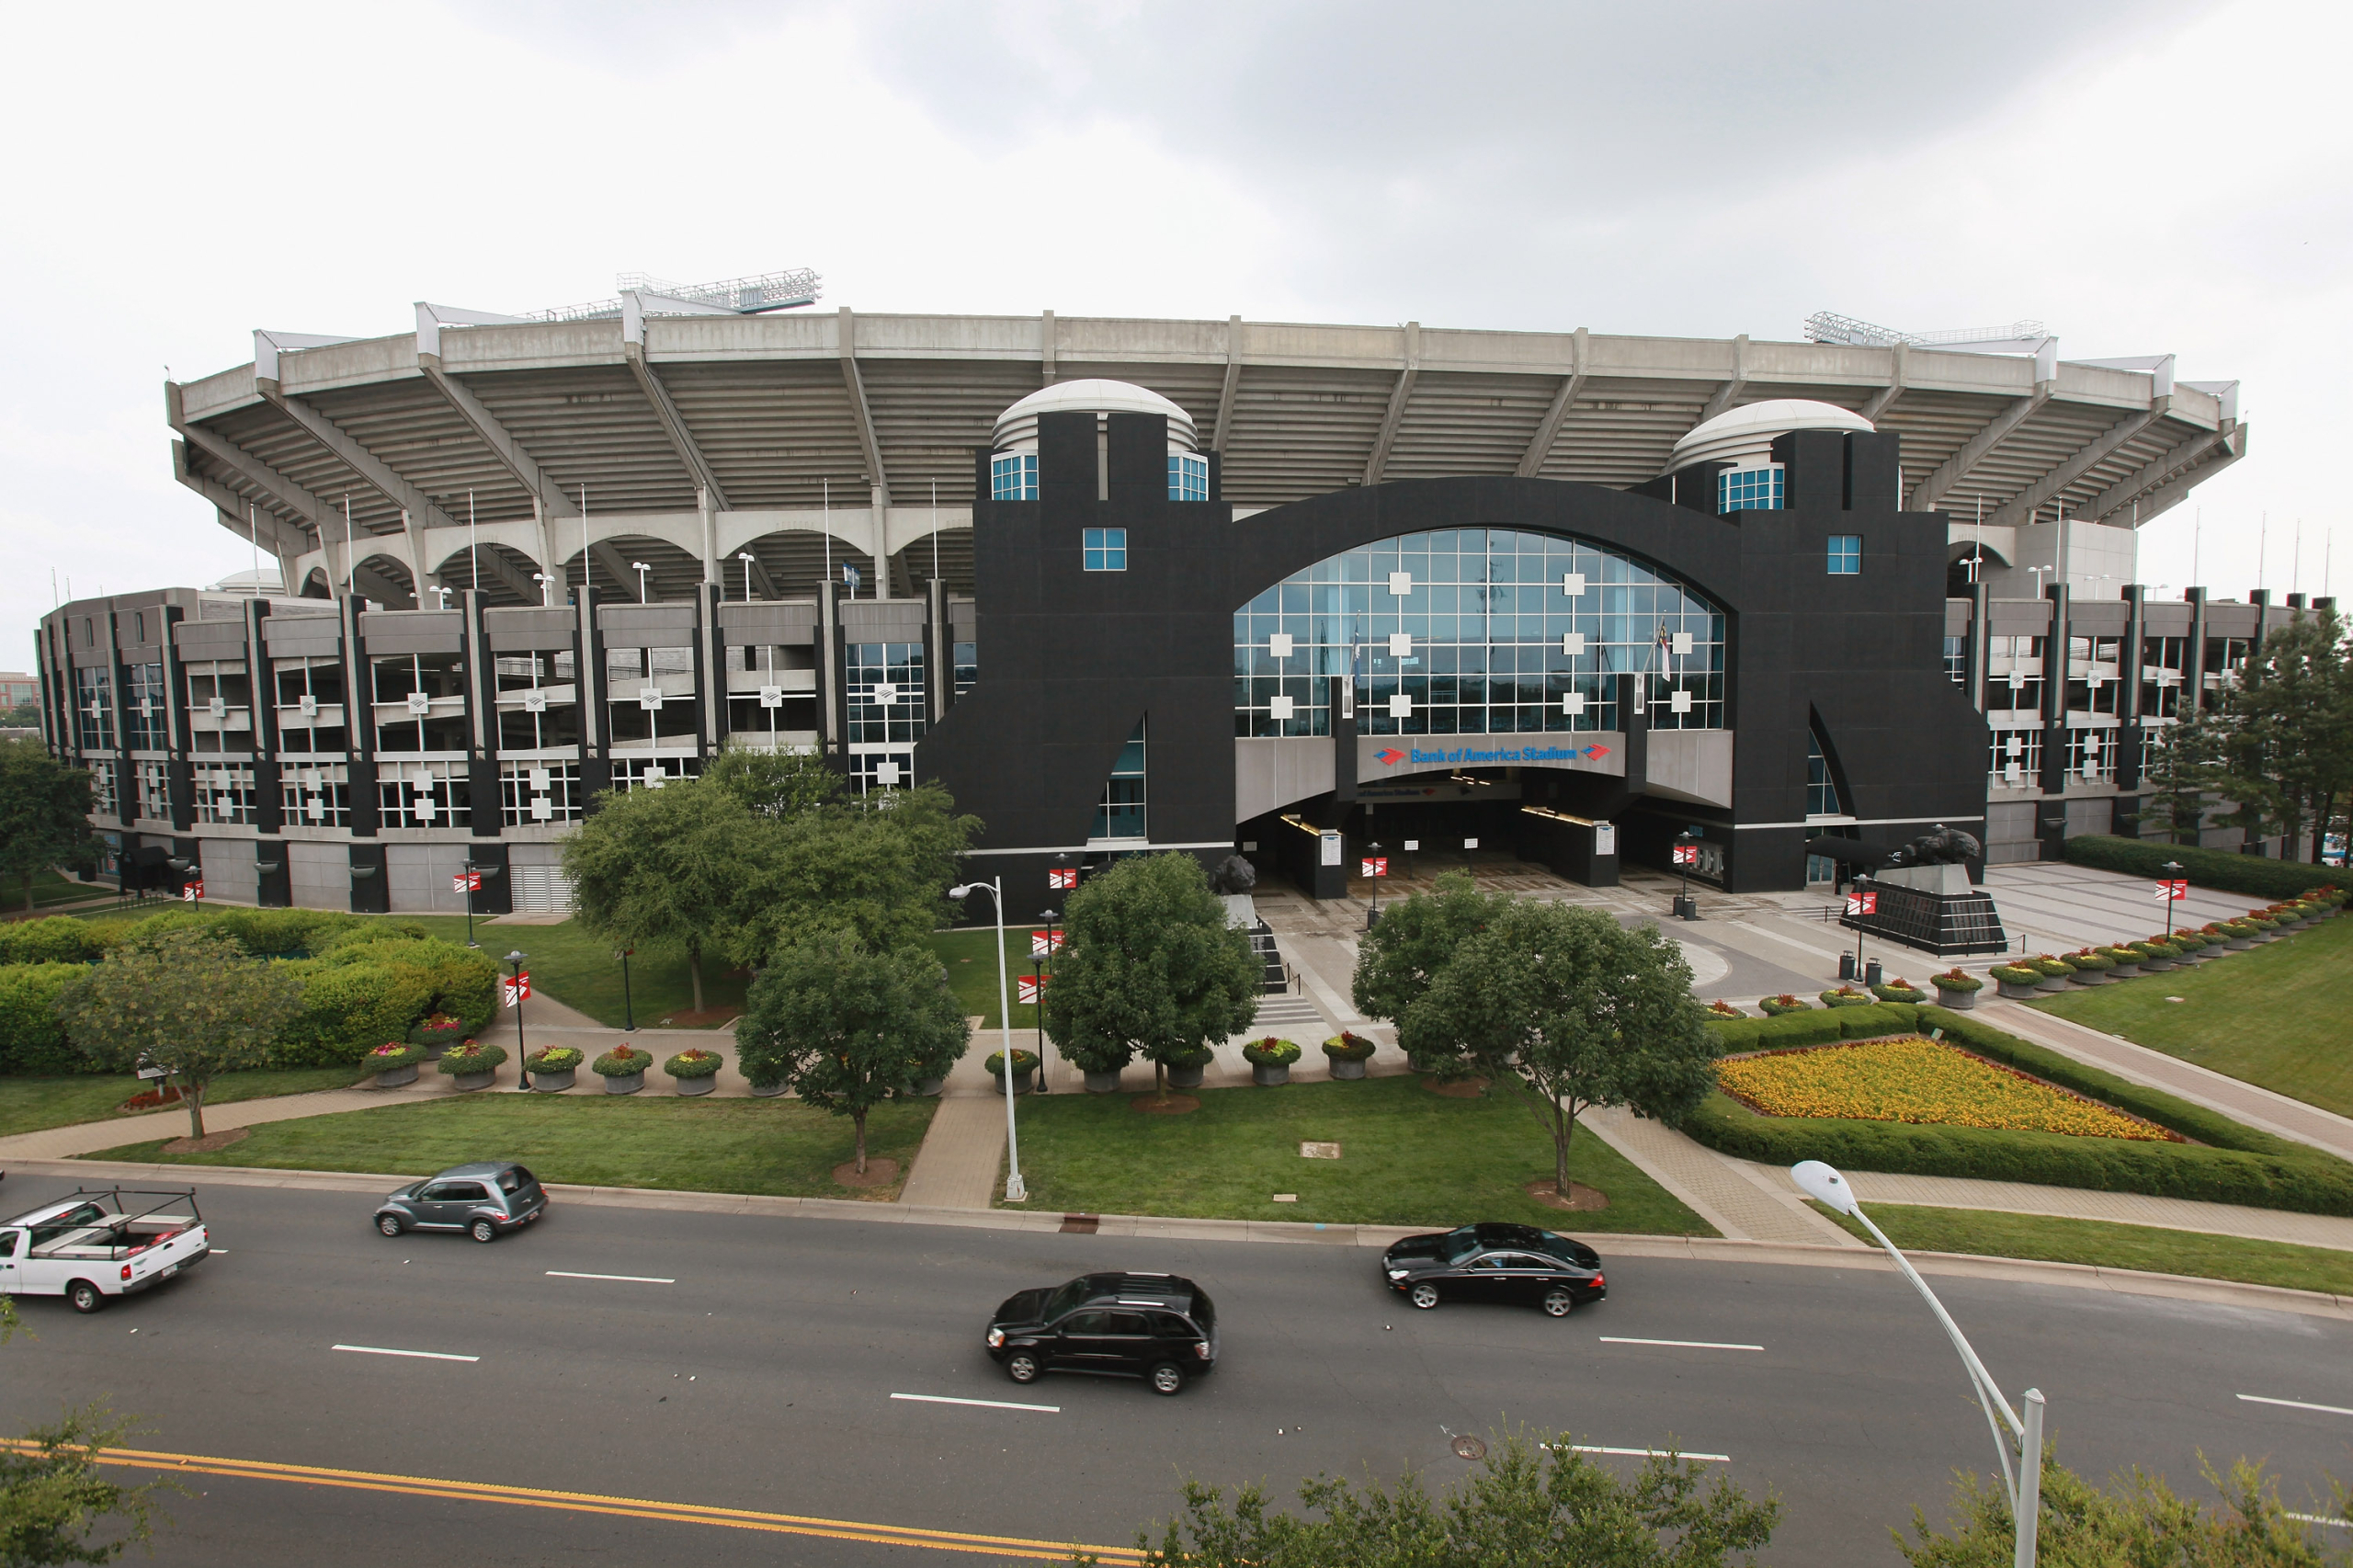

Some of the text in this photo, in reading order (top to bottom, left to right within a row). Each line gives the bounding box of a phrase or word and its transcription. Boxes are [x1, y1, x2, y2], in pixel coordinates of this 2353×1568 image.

[1411, 745, 1577, 763] Bank of America Stadium
